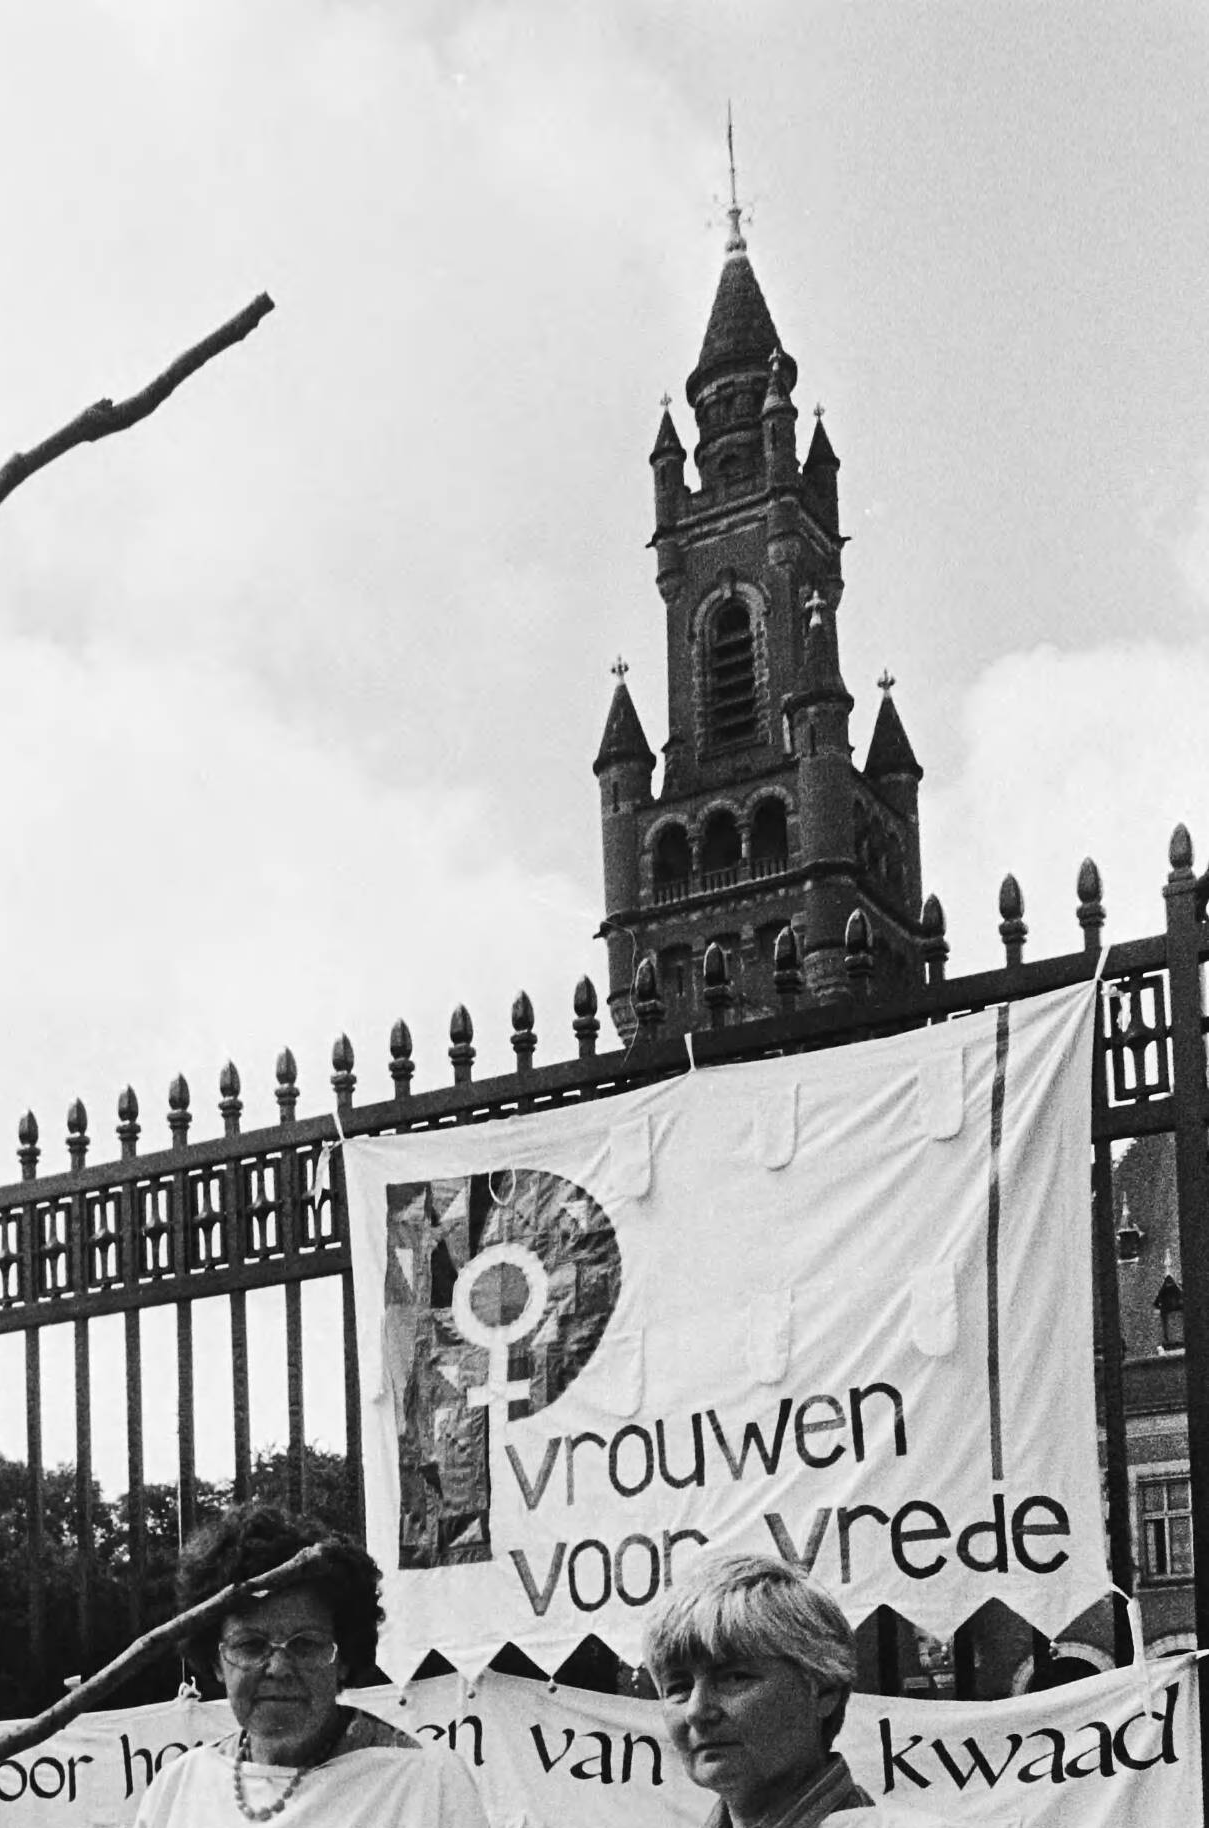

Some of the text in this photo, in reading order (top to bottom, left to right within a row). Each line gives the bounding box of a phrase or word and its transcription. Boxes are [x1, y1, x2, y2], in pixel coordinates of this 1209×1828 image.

[505, 1382, 907, 1511] vrouwen
[508, 1494, 1071, 1616] voor vrede
[530, 1723, 663, 1785] van
[878, 1681, 1180, 1795] kwaad
